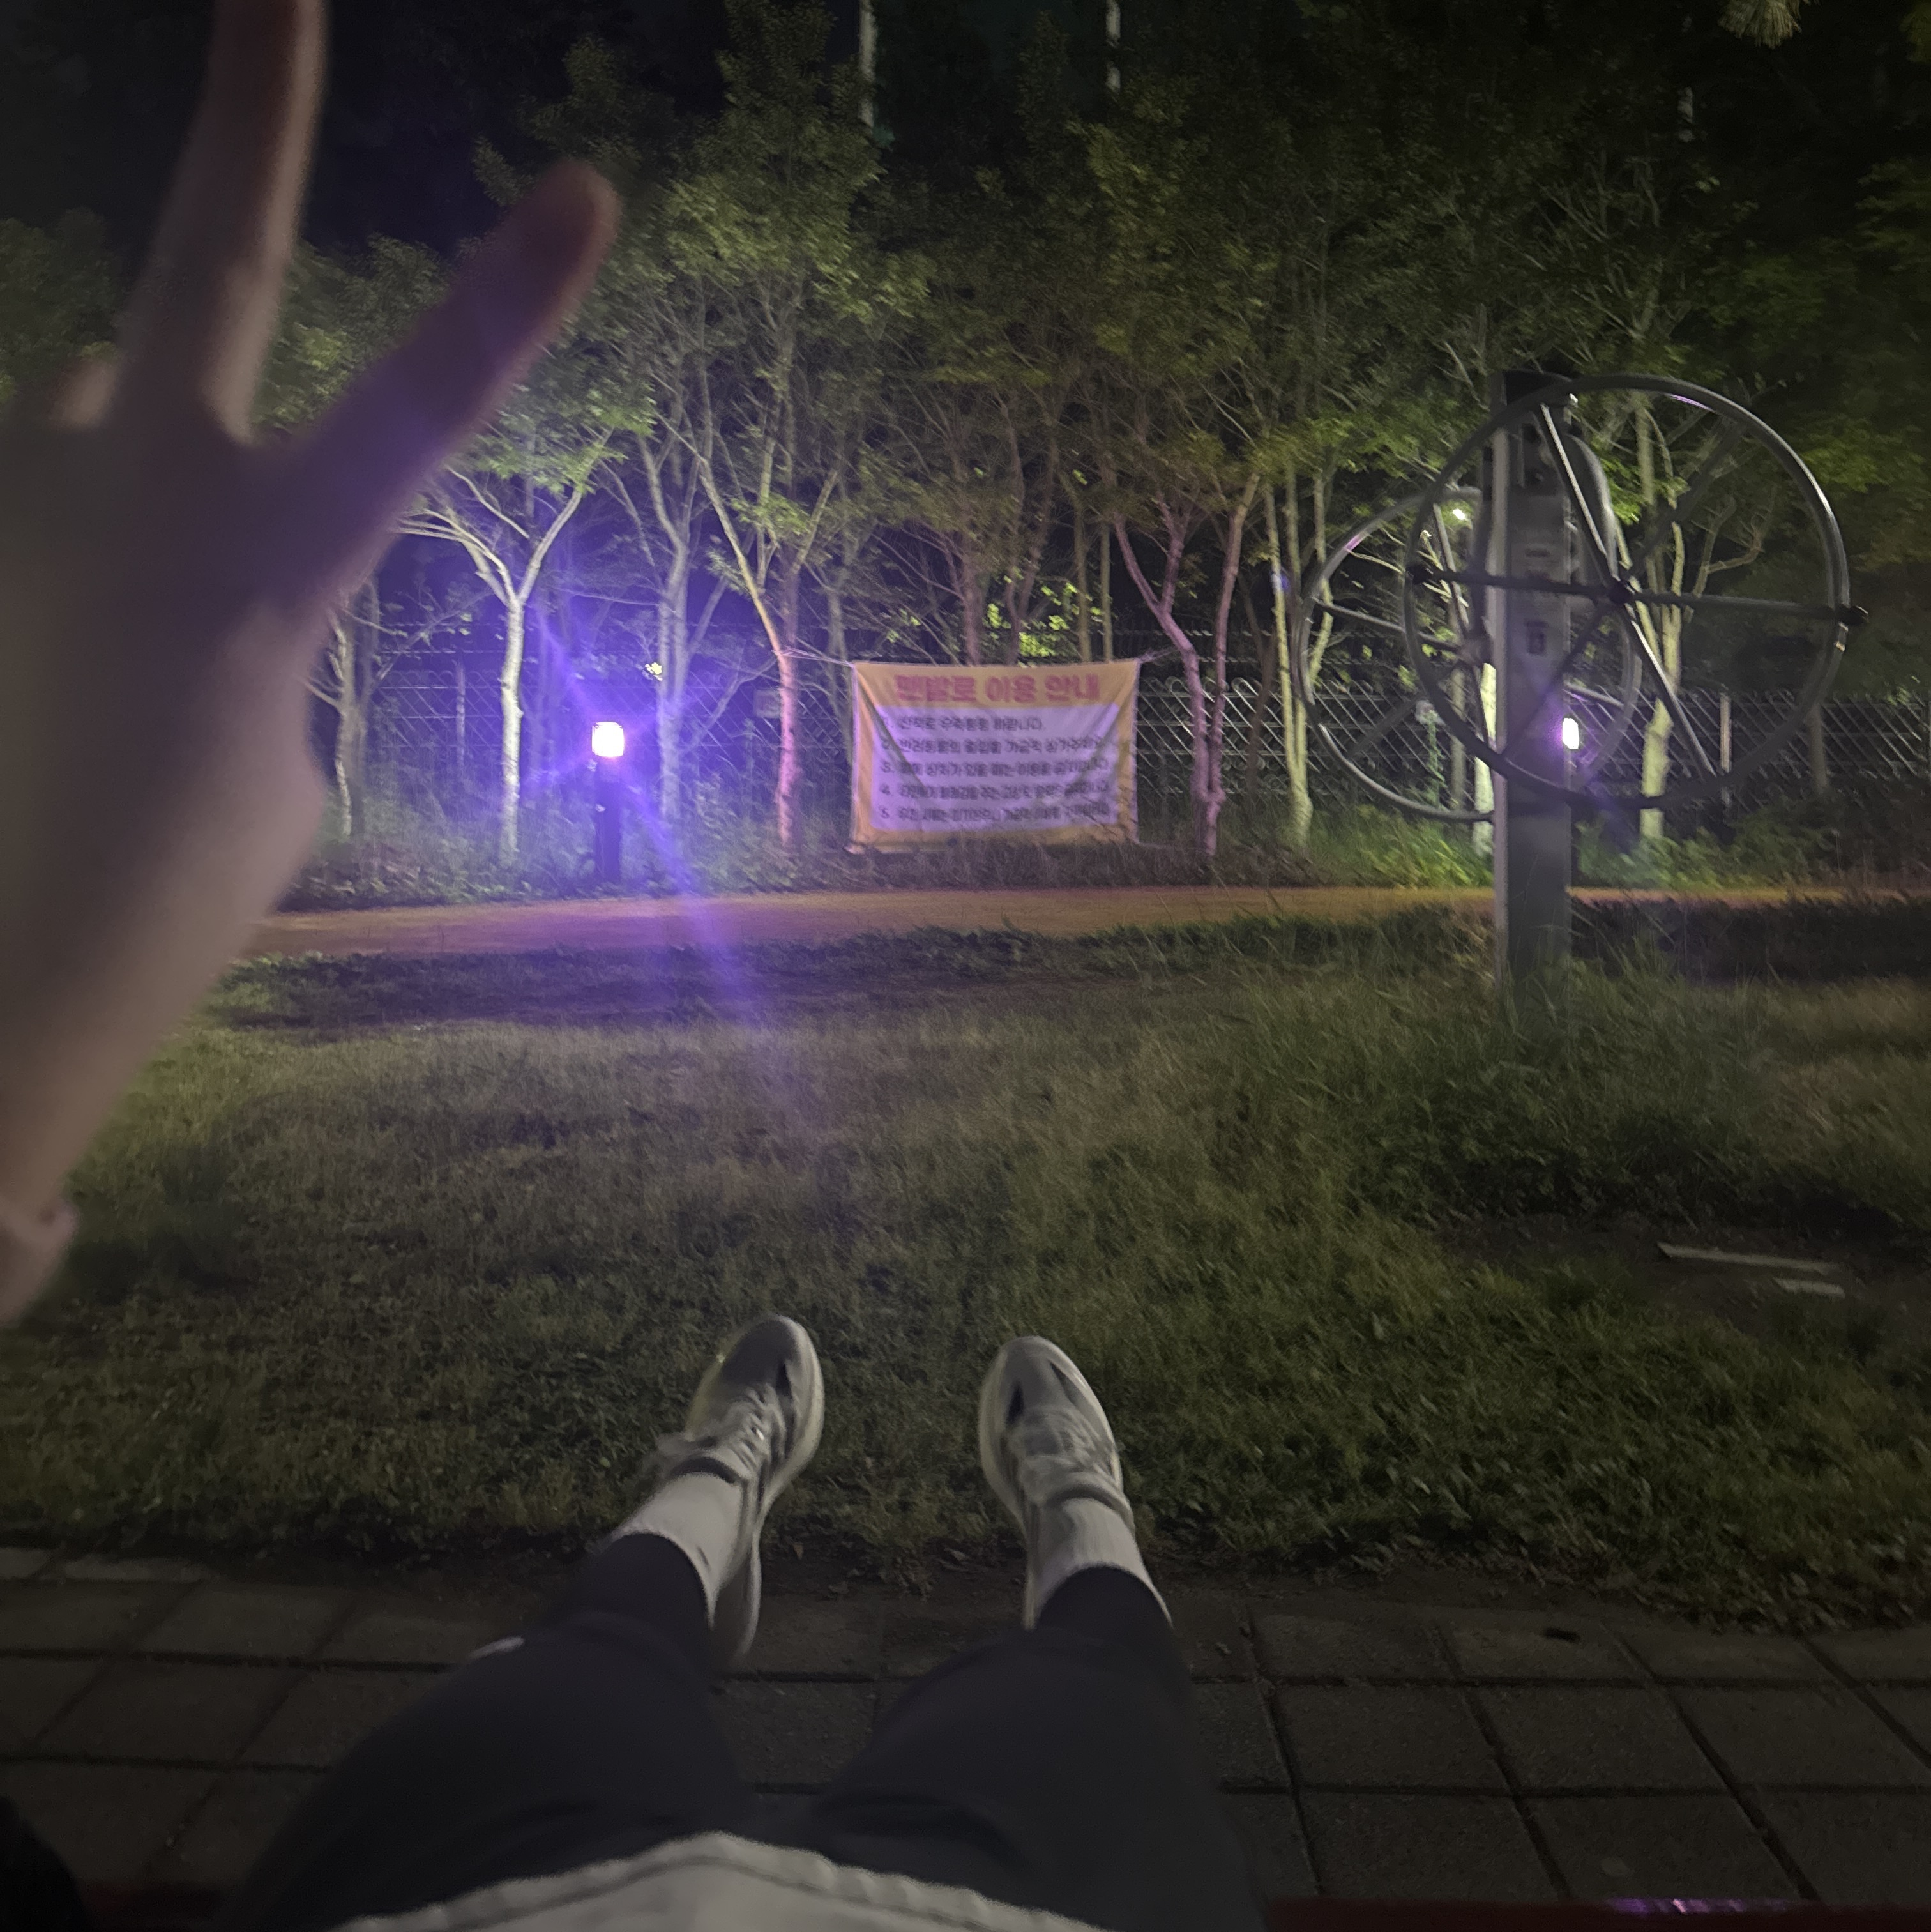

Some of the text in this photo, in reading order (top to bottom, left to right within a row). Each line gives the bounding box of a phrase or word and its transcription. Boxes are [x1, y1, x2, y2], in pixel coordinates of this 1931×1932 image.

[895, 673, 1100, 703] 맨발로 이용 안내
